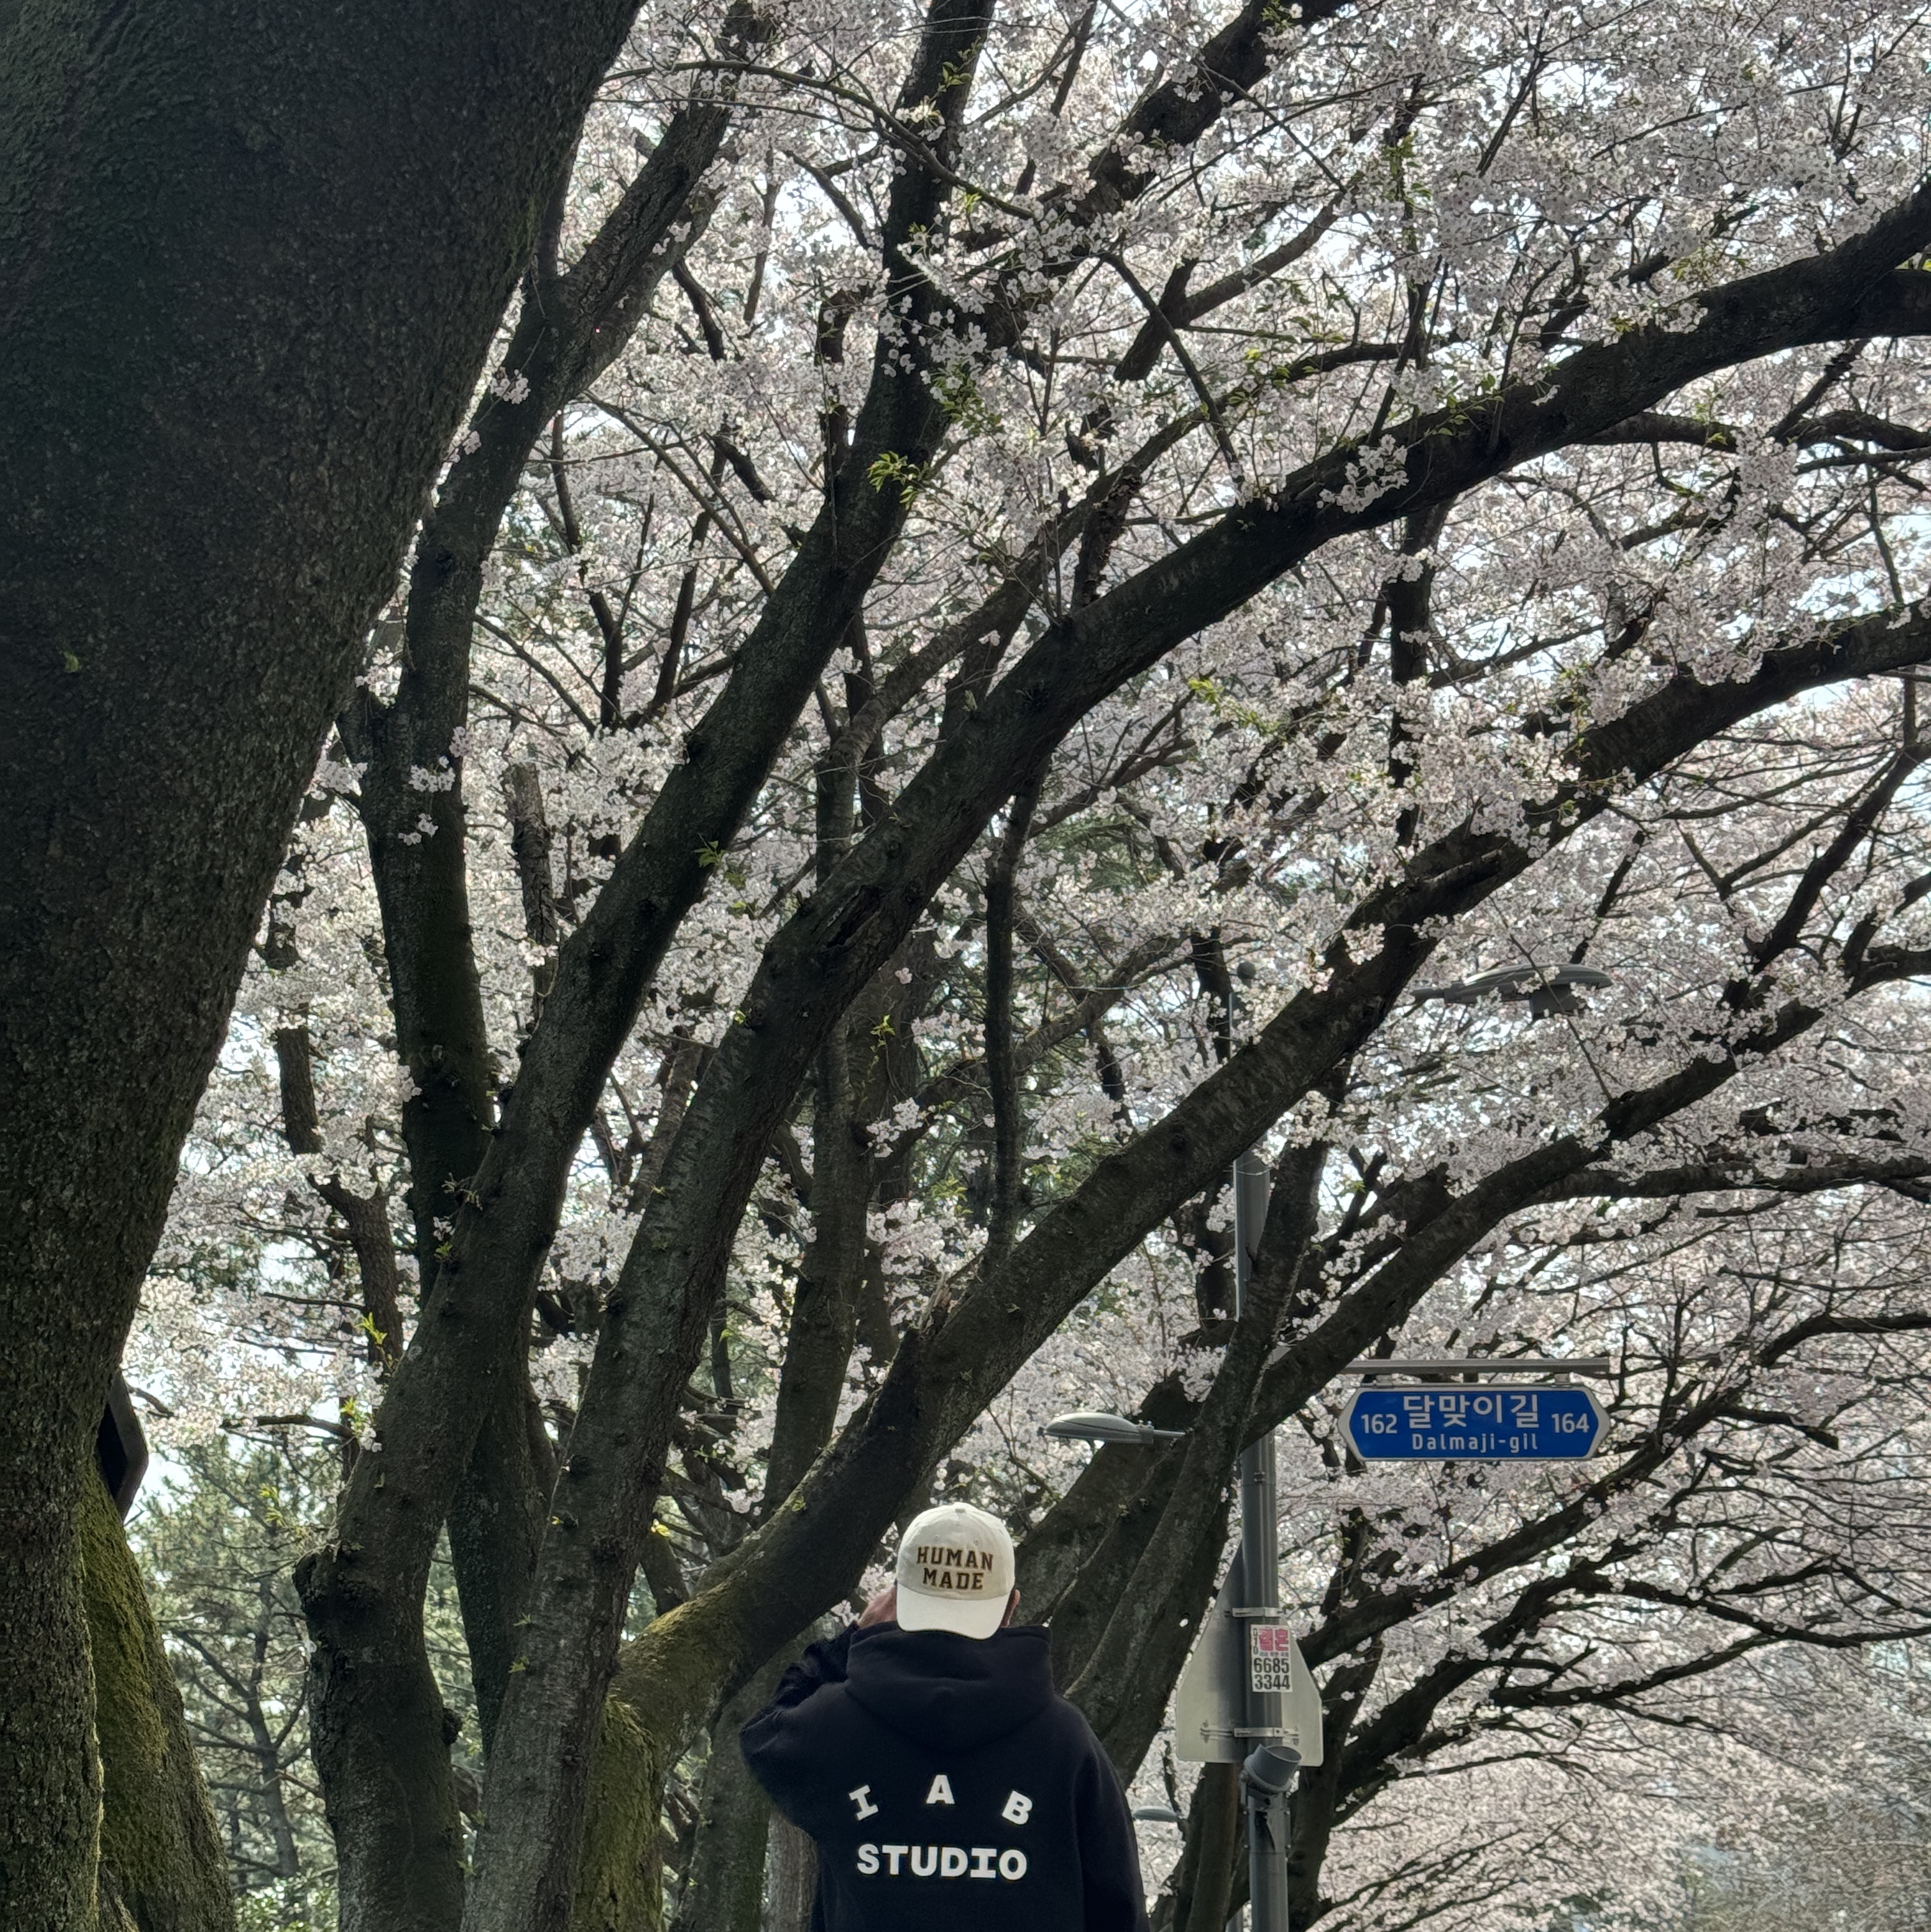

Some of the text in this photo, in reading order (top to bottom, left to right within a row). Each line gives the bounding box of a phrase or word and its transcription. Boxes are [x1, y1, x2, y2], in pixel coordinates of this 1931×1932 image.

[1361, 1394, 1590, 1434] 162 달맞이길 164
[1412, 1433, 1538, 1453] Dalmaji-gil
[916, 1546, 993, 1571] HUMAN
[922, 1567, 984, 1590] MADE
[1253, 1657, 1290, 1673] 6685
[1254, 1674, 1290, 1690] 3344
[857, 1843, 1028, 1881] STUDIO
